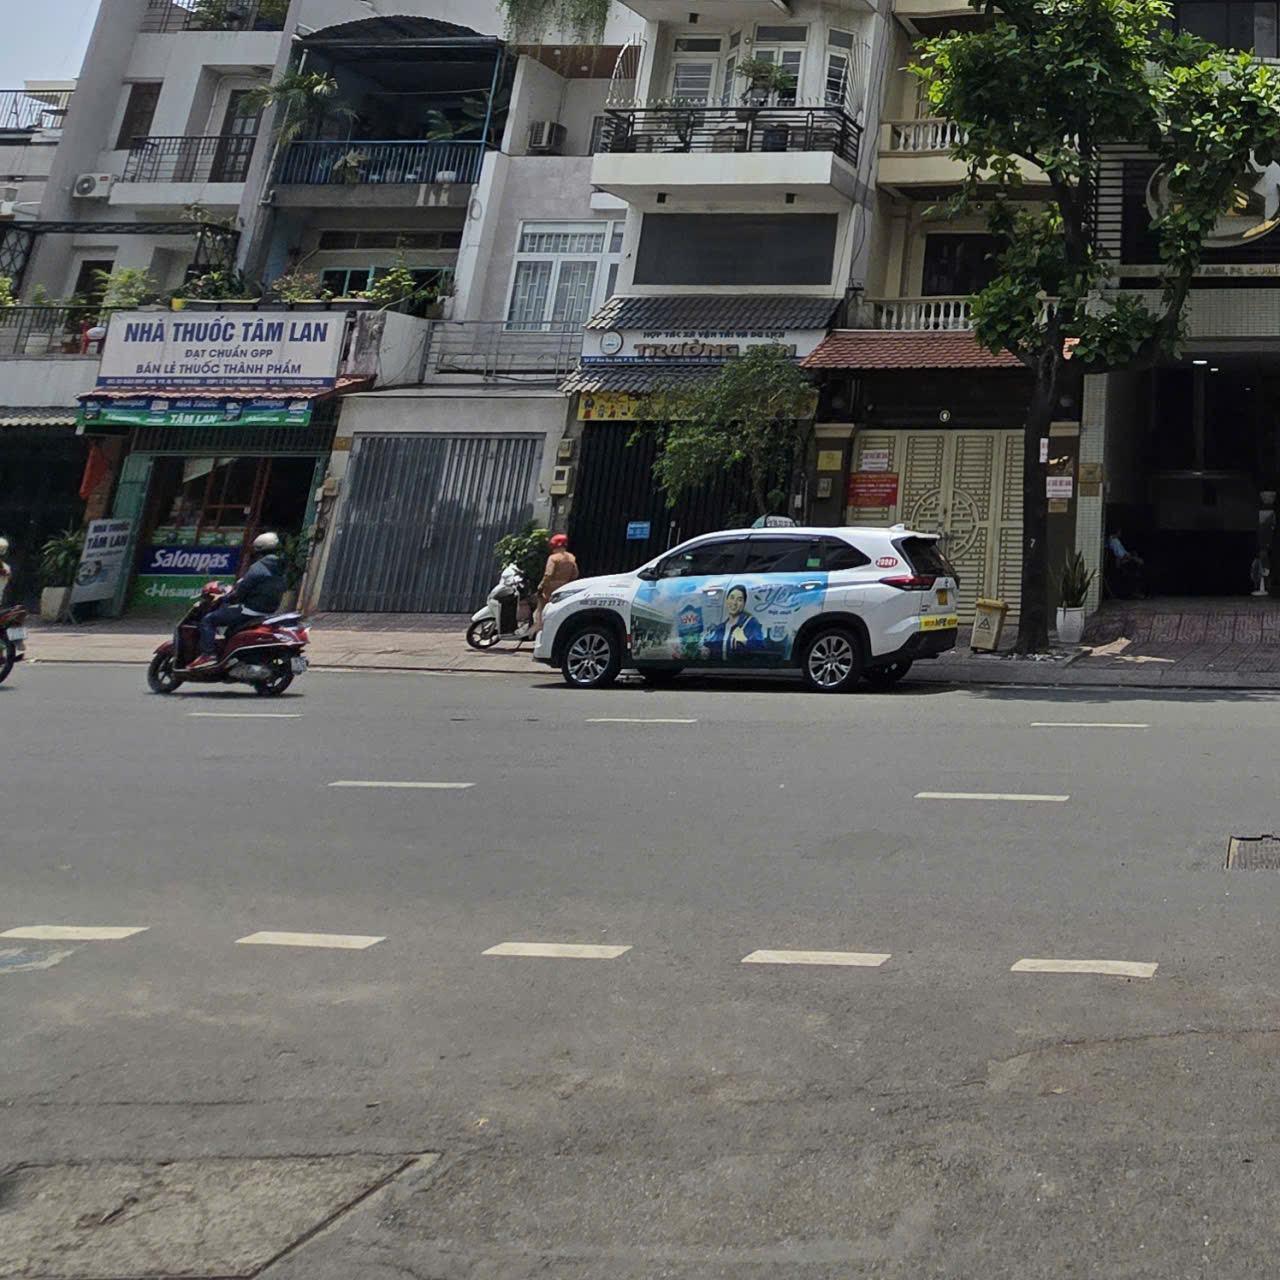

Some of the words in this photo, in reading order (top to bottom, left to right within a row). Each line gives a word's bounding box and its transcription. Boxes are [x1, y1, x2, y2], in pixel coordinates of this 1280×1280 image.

[124, 319, 165, 343] NHÀ
[172, 316, 236, 343] THUỐC
[242, 318, 284, 343] TÂM
[289, 322, 329, 343] LAN
[185, 349, 207, 360] ĐẠT
[209, 345, 248, 359] CHUẨN
[251, 349, 273, 359] GPP
[634, 339, 740, 358] TRƯỜNG
[136, 362, 160, 375] BÁN
[164, 362, 176, 375] LẺ
[177, 358, 220, 375] THUỐC
[224, 362, 263, 375] THÀNH
[267, 359, 302, 375] PHẨM
[151, 549, 230, 571] Salonpas
